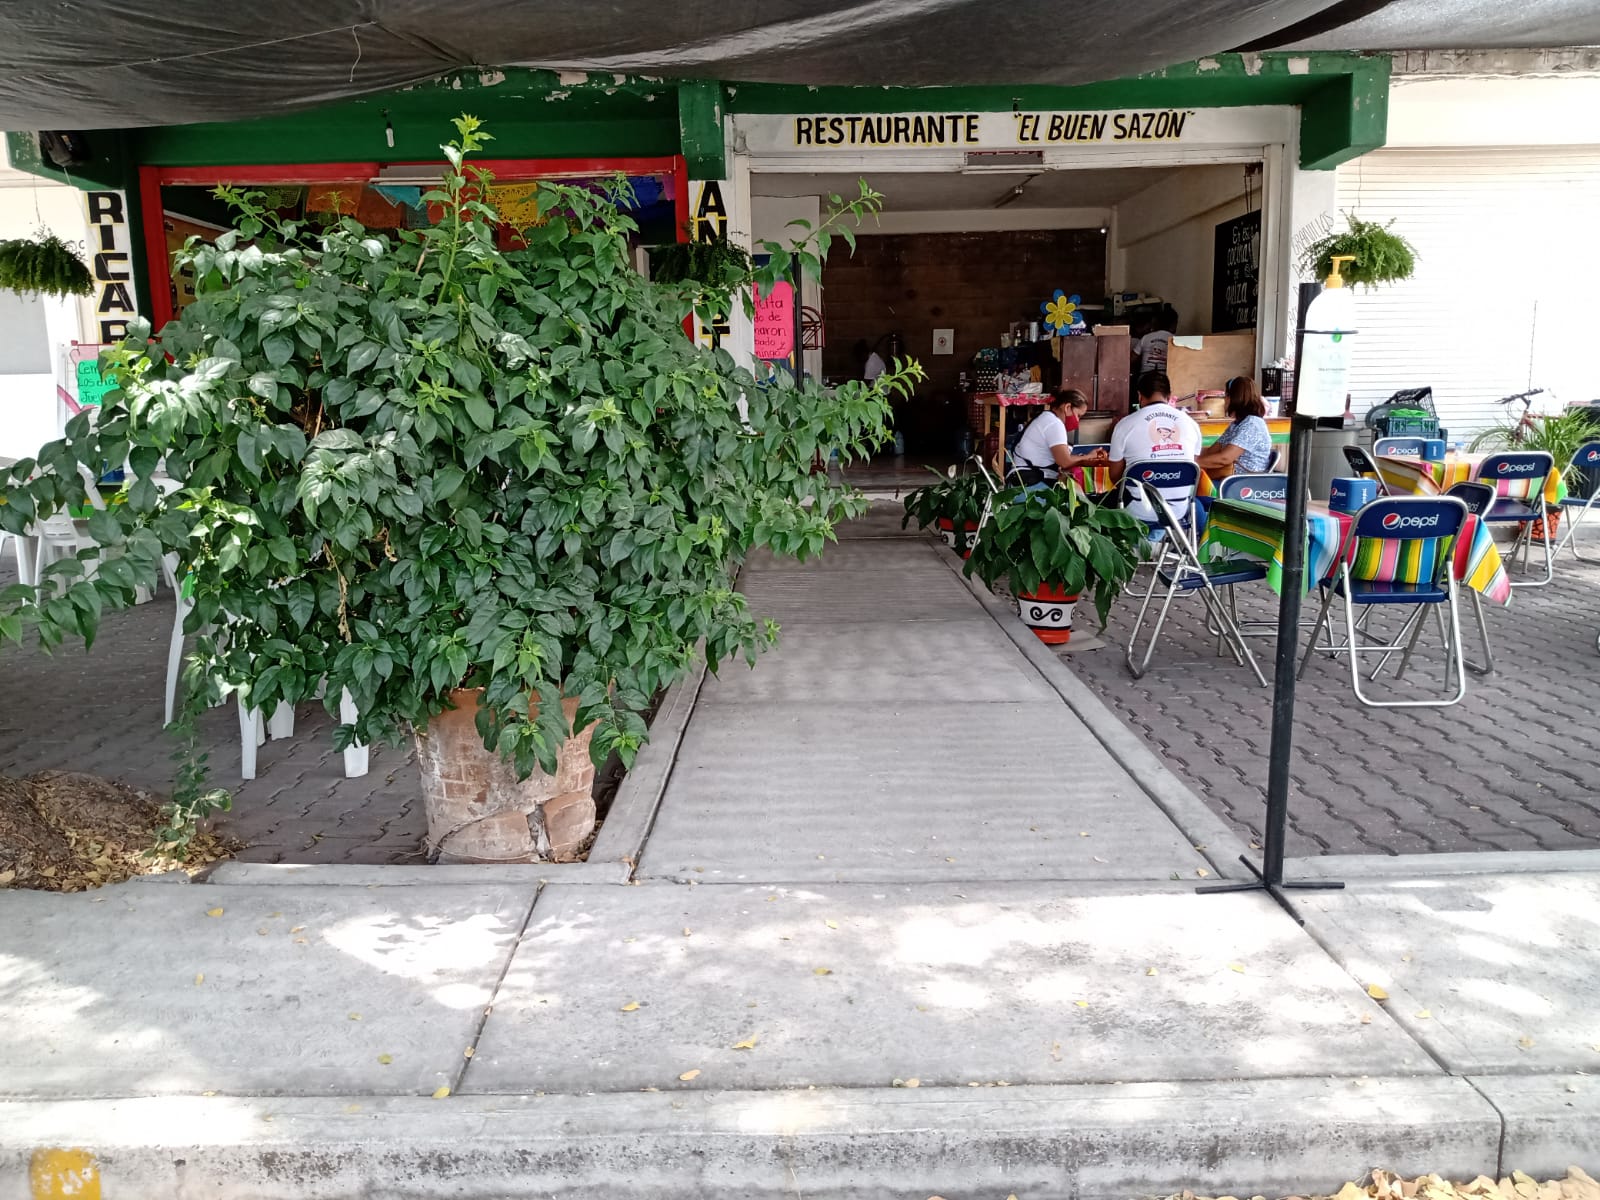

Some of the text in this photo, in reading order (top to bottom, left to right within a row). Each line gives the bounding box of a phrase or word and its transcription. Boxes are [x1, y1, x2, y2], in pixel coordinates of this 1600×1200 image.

[794, 114, 980, 145] RESTAURANTE
[1046, 113, 1108, 142] BUEN
[768, 311, 782, 322] de
[1396, 446, 1419, 456] pepsi
[1508, 462, 1536, 473] pepsi
[1153, 470, 1181, 481] pepsi
[1254, 487, 1286, 501] pepsi
[1400, 513, 1440, 529] pepsi
